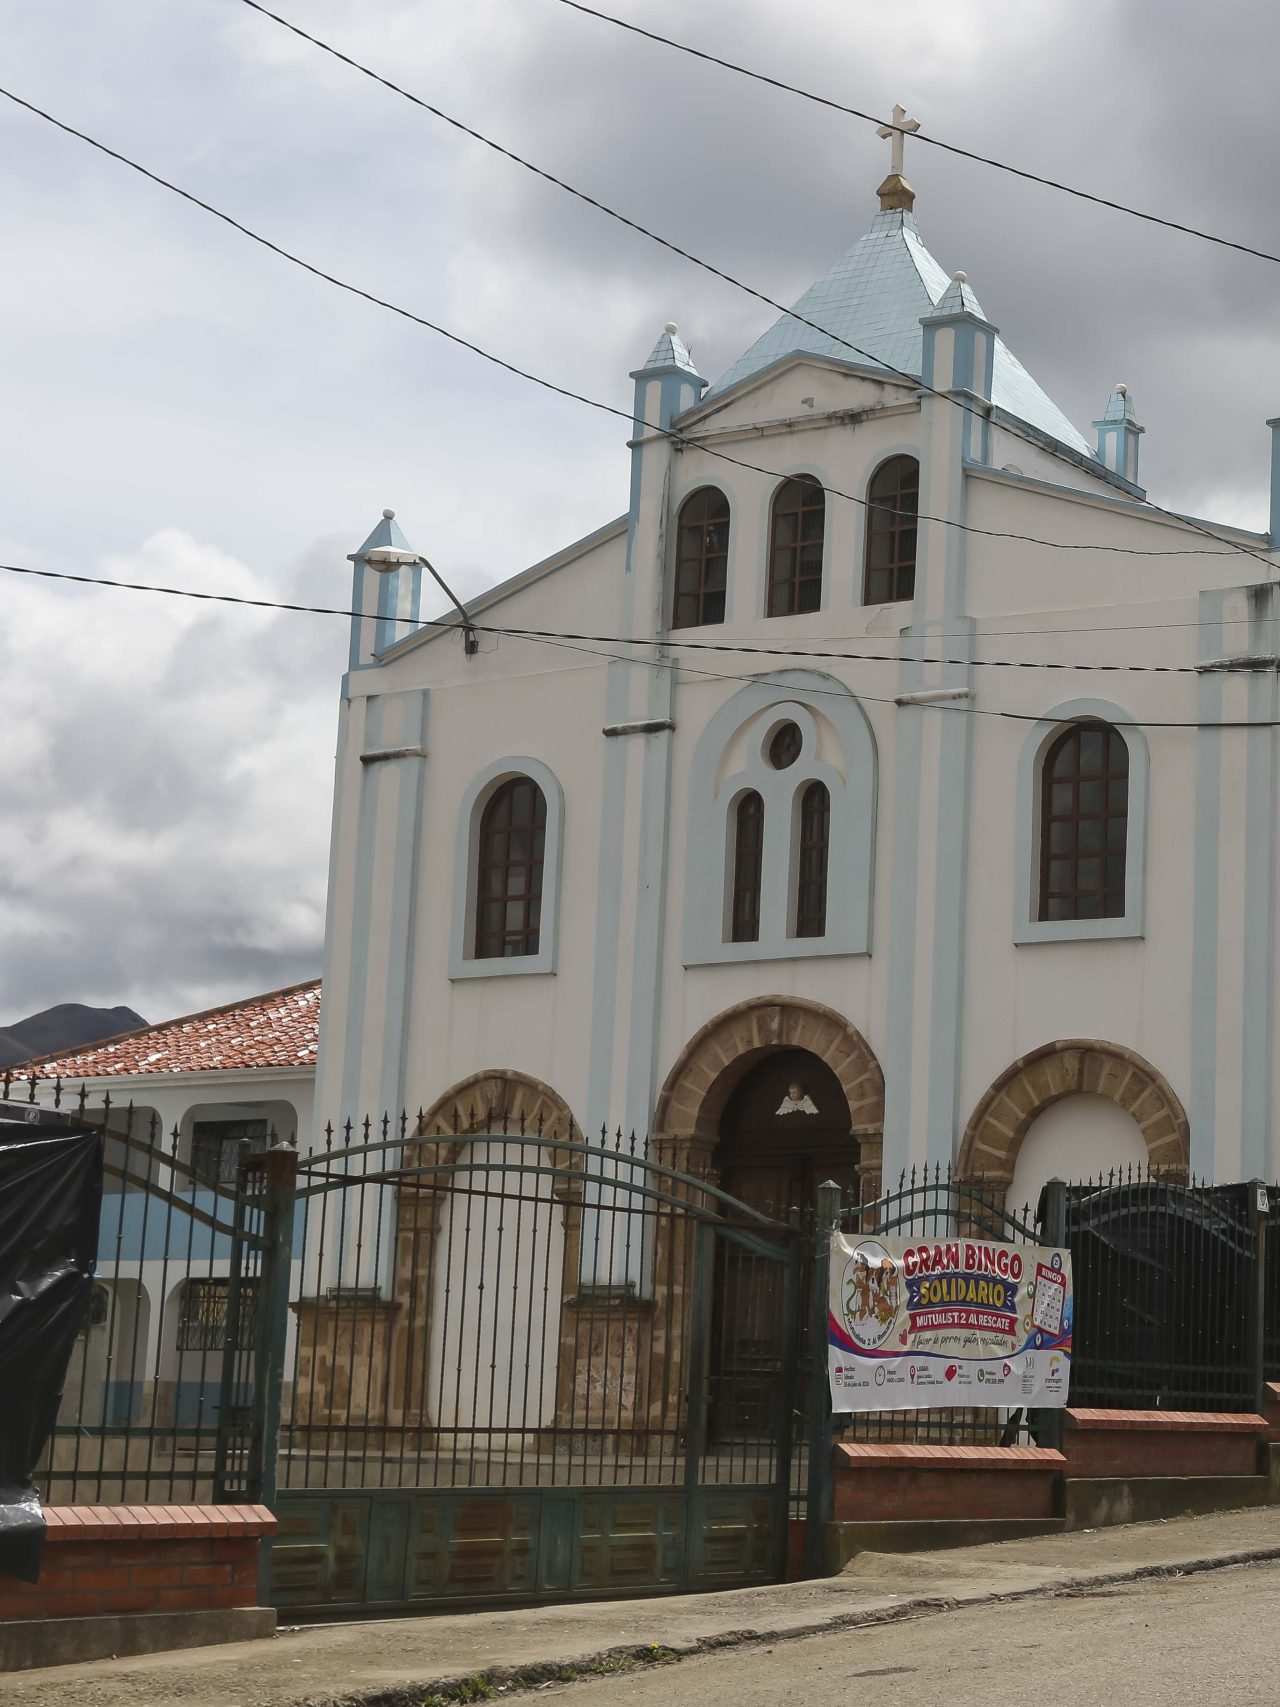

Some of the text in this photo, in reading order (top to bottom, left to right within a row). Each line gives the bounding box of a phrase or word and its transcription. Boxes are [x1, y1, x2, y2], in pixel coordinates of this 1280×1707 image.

[903, 1243, 1023, 1280] GRAN BINGO
[1042, 1267, 1062, 1283] BINGO
[919, 1277, 1006, 1307] SOLIDARIO
[960, 1312, 967, 1324] 2
[968, 1313, 978, 1325] AL
[979, 1315, 1010, 1331] RESCATE
[917, 1334, 931, 1349] favor
